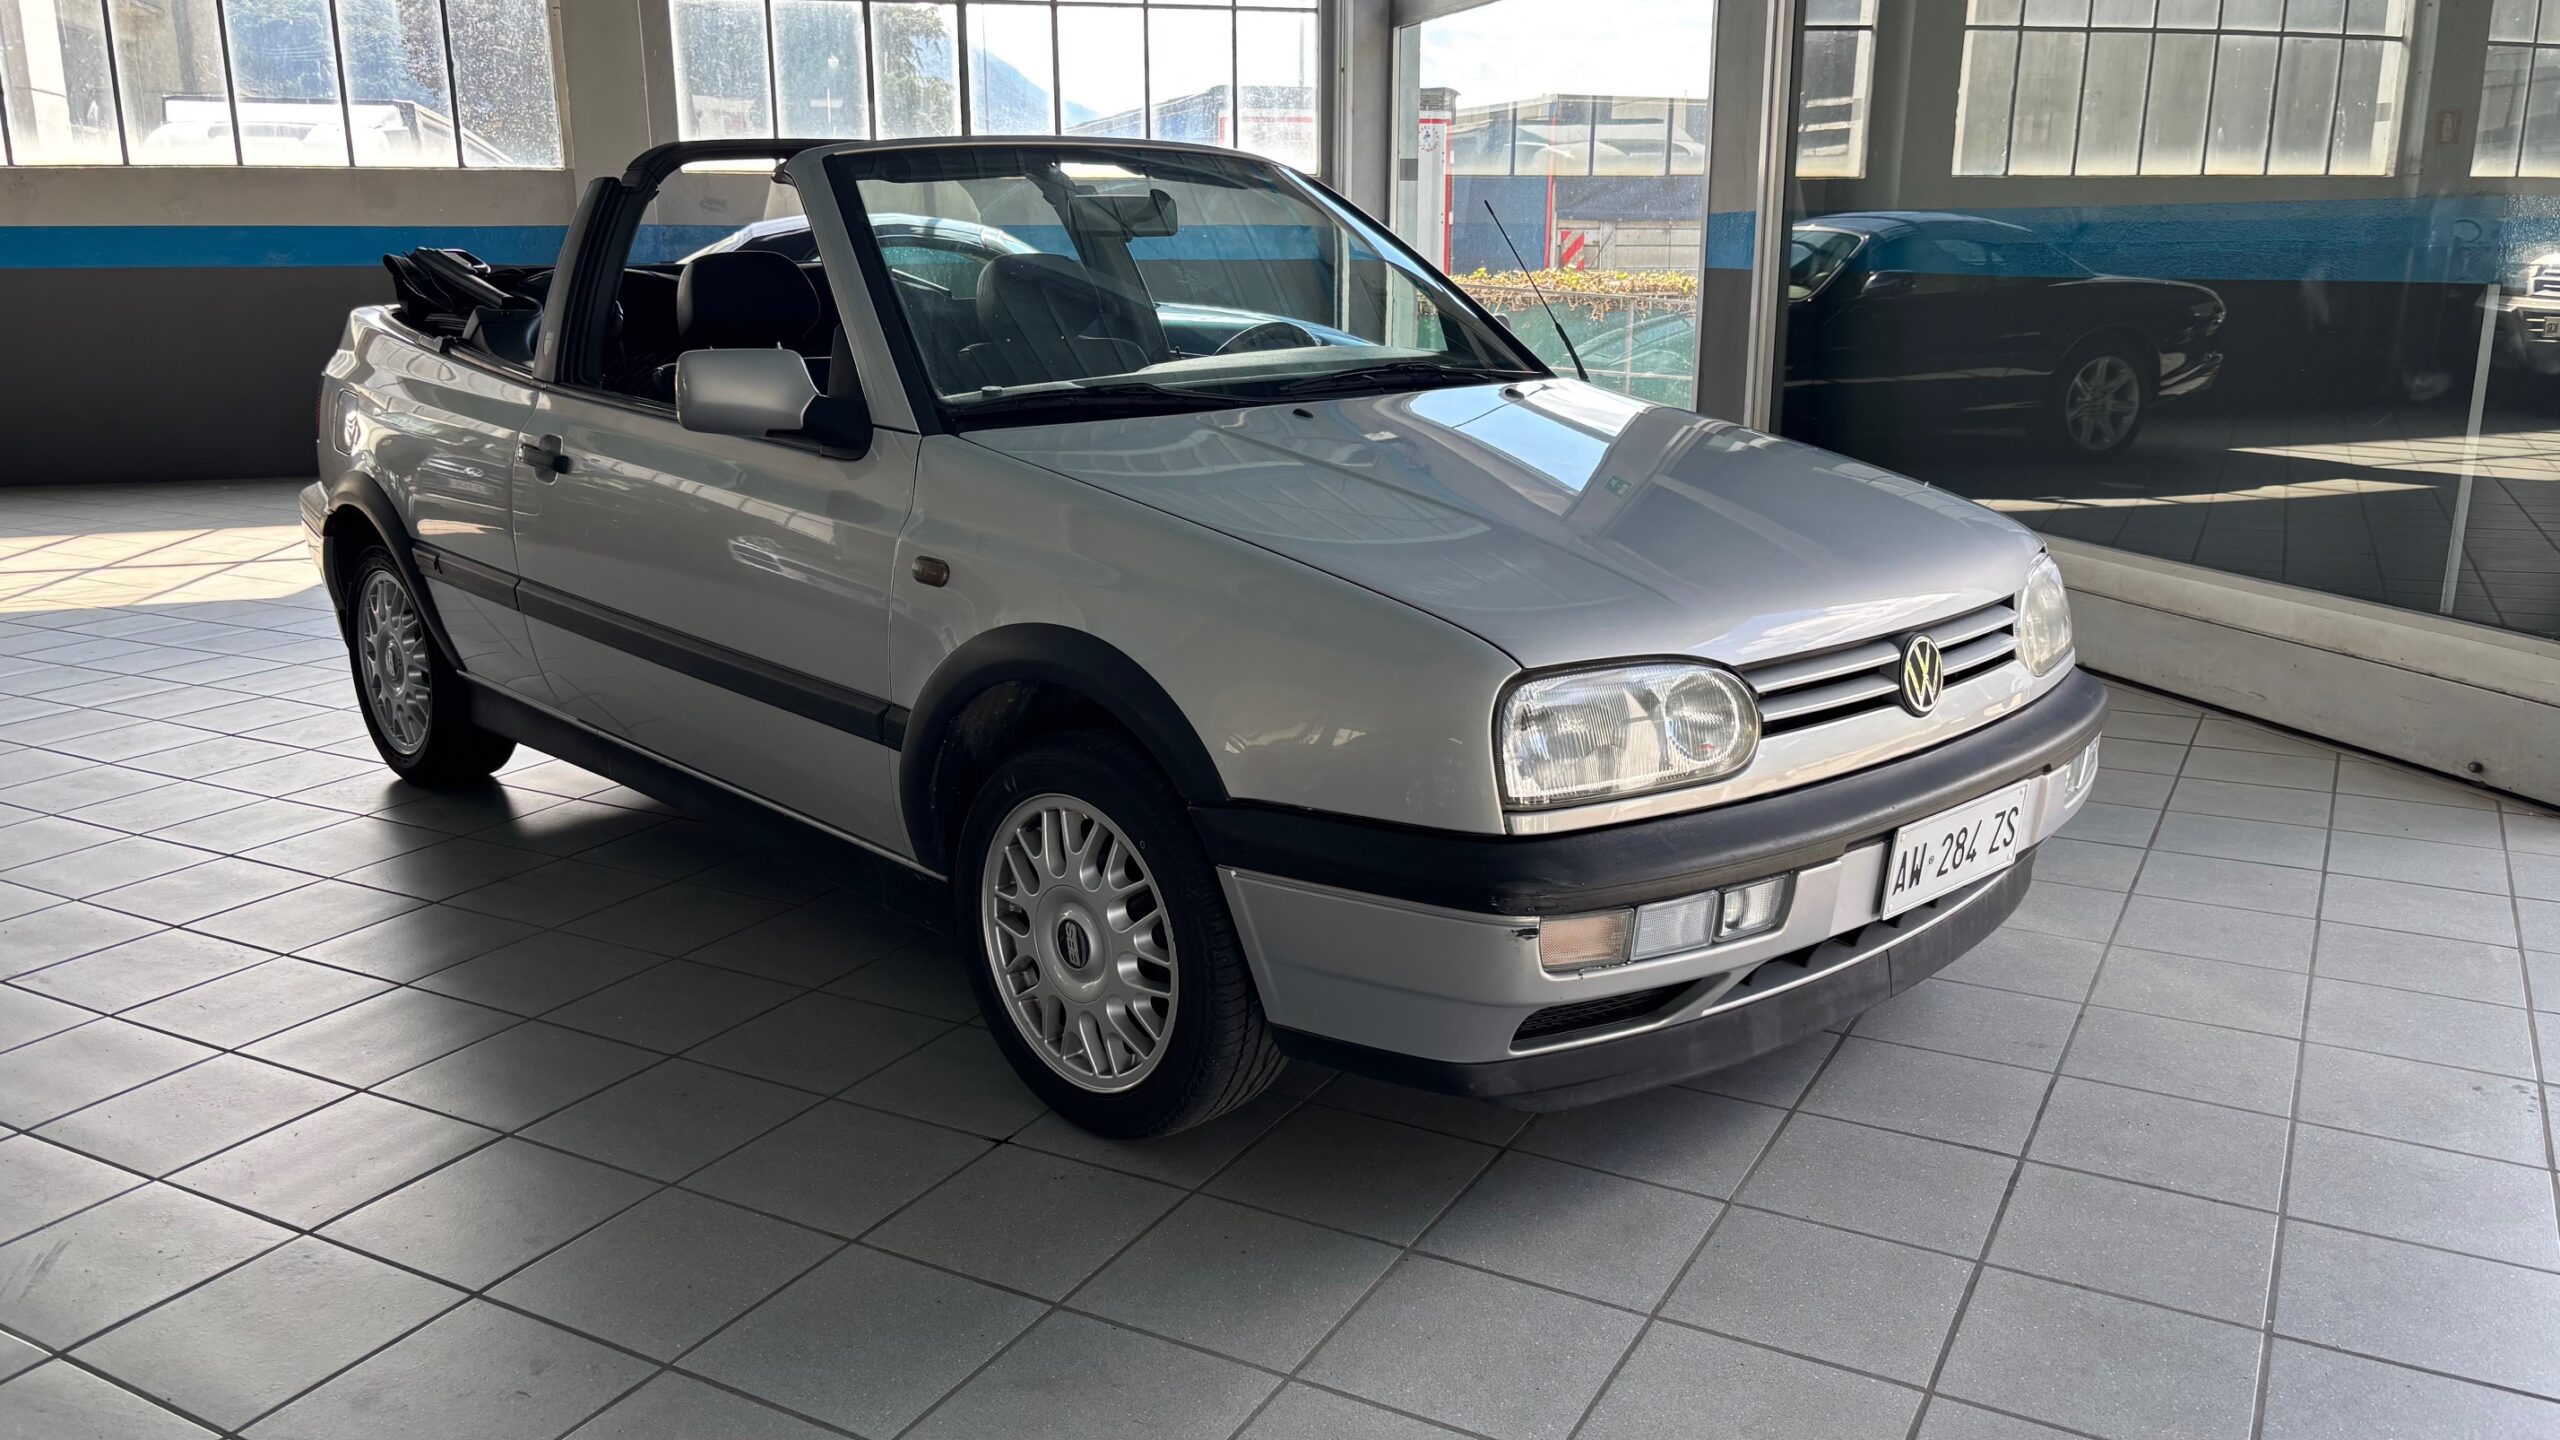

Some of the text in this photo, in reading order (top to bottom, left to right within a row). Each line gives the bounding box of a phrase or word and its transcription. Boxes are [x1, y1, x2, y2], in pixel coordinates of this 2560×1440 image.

[1892, 806, 2019, 896] AW 284 ZS
[1065, 921, 1081, 967] BBS
